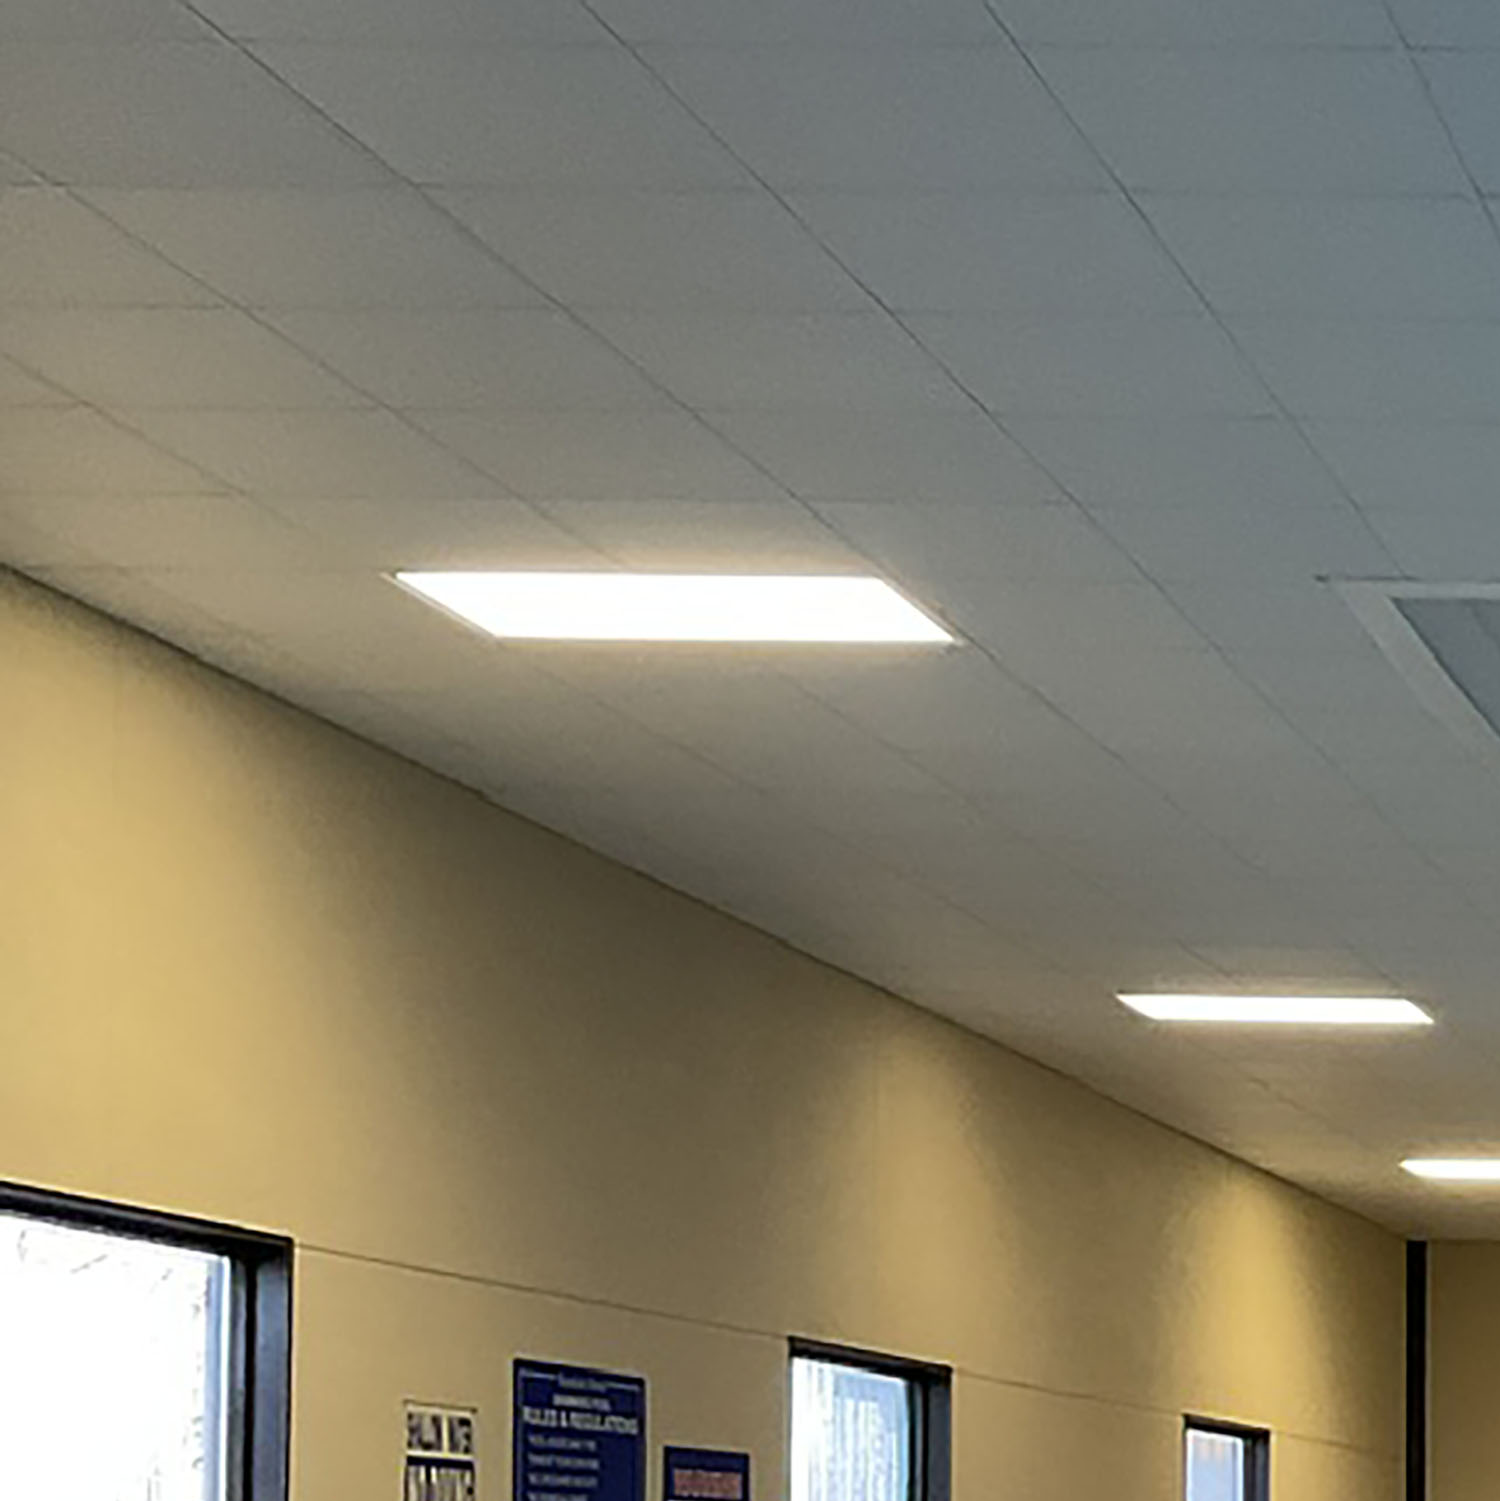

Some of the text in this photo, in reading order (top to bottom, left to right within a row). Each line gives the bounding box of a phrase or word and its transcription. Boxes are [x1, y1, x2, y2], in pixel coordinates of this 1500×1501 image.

[523, 1406, 638, 1435] RULES & REGULATIONS
